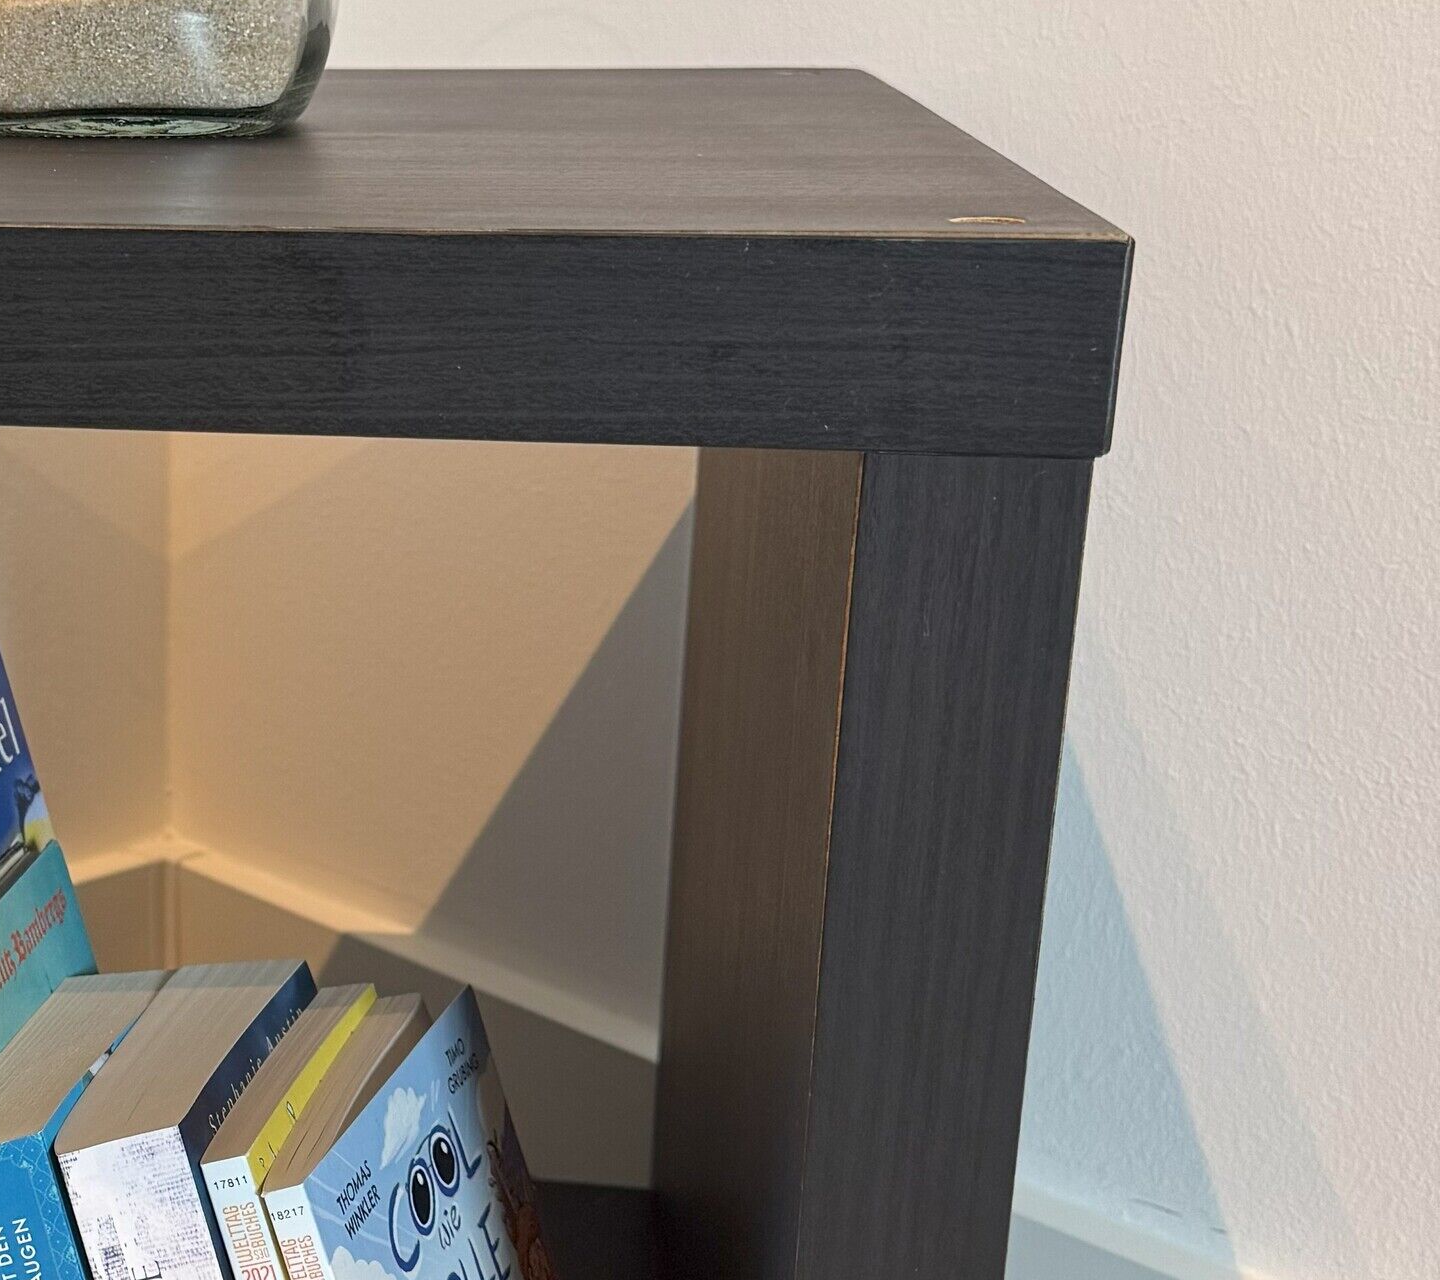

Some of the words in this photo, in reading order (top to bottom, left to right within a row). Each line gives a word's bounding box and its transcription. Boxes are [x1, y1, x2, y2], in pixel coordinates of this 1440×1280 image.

[214, 1175, 248, 1191] 17811
[336, 1160, 372, 1216] THOMAS
[389, 1111, 481, 1273] COOL
[223, 1205, 253, 1265] WELTTAG
[240, 1201, 267, 1249] BUCHES
[271, 1205, 304, 1221] 18217
[344, 1184, 381, 1240] WINKLER
[297, 1235, 324, 1280] BUCHES
